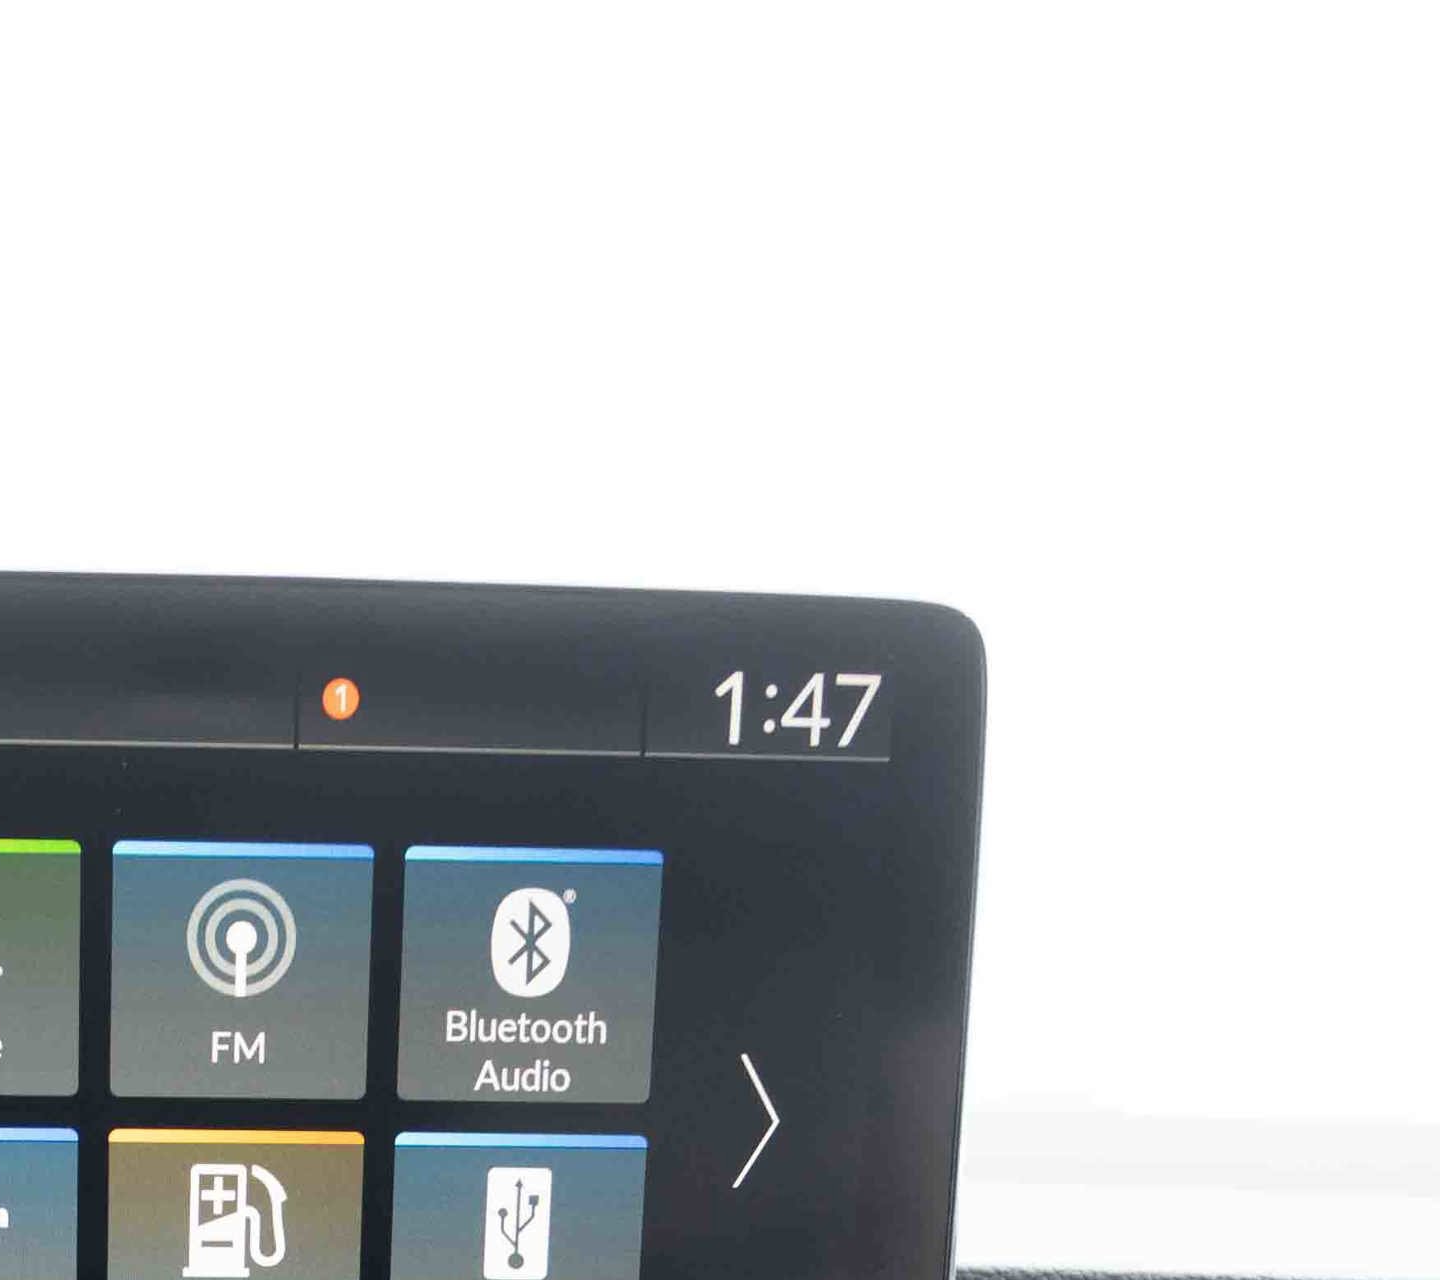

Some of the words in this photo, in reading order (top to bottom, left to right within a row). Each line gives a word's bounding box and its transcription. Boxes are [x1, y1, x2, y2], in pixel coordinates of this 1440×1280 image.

[333, 683, 349, 715] 1
[714, 670, 883, 749] 1:47
[445, 1010, 607, 1045] Bluetooth
[210, 1031, 266, 1064] FM
[473, 1058, 571, 1093] Audio
